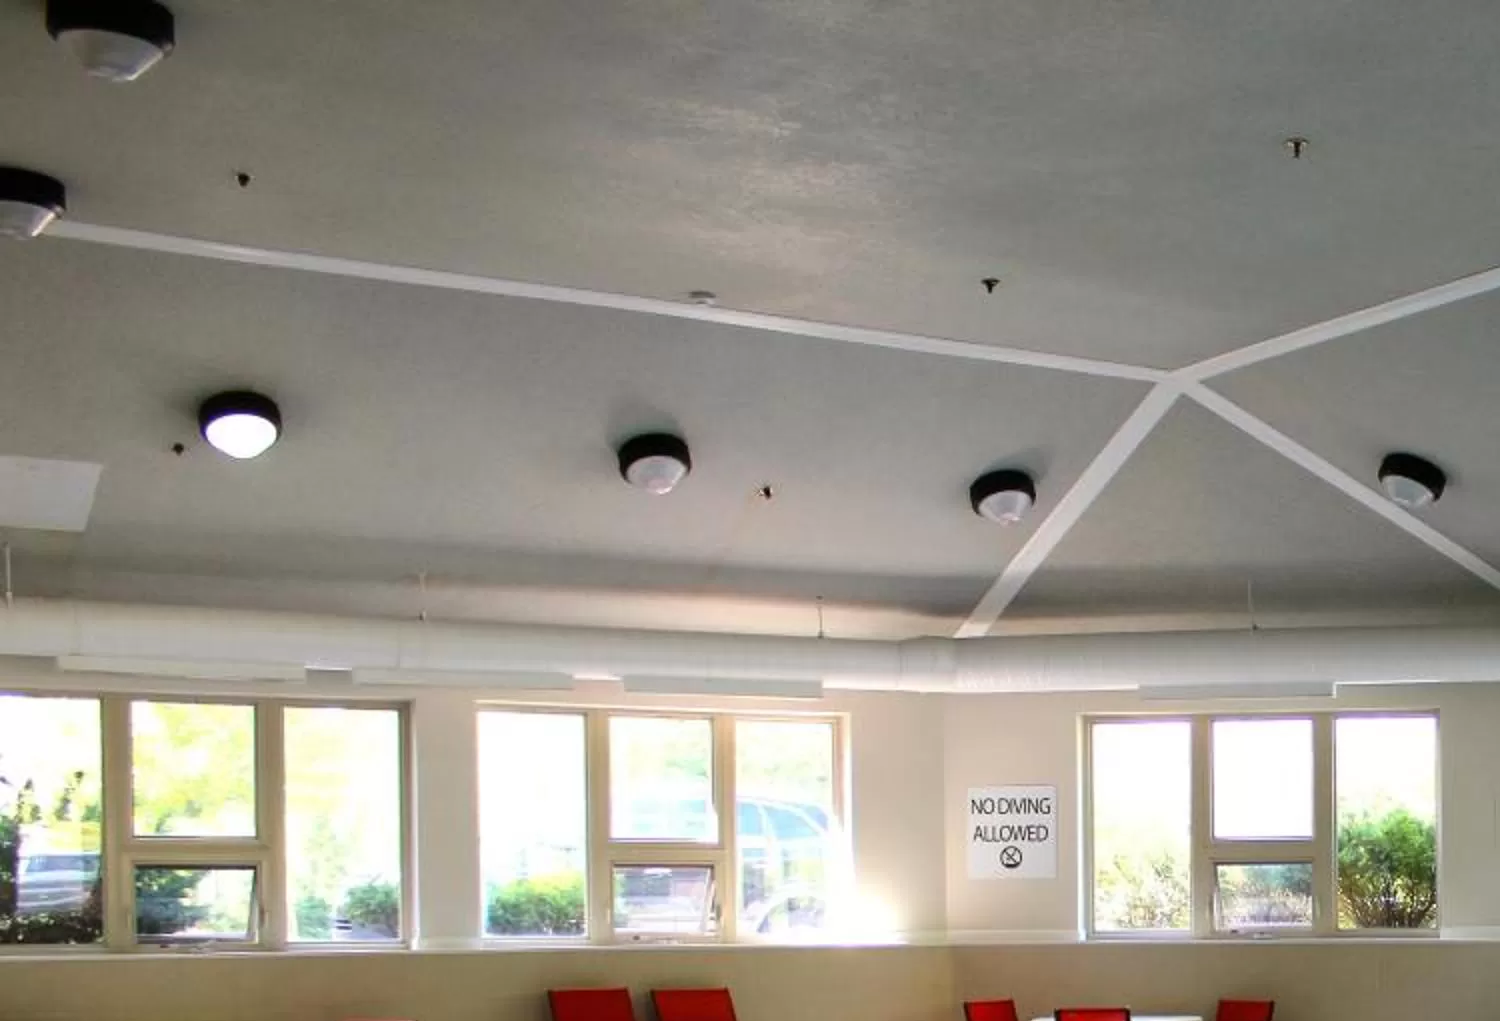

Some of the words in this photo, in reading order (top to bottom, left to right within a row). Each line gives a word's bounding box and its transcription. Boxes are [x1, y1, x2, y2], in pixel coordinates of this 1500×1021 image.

[971, 797, 995, 815] NO
[997, 797, 1051, 815] DIVING
[973, 824, 1049, 843] ALLOWED
